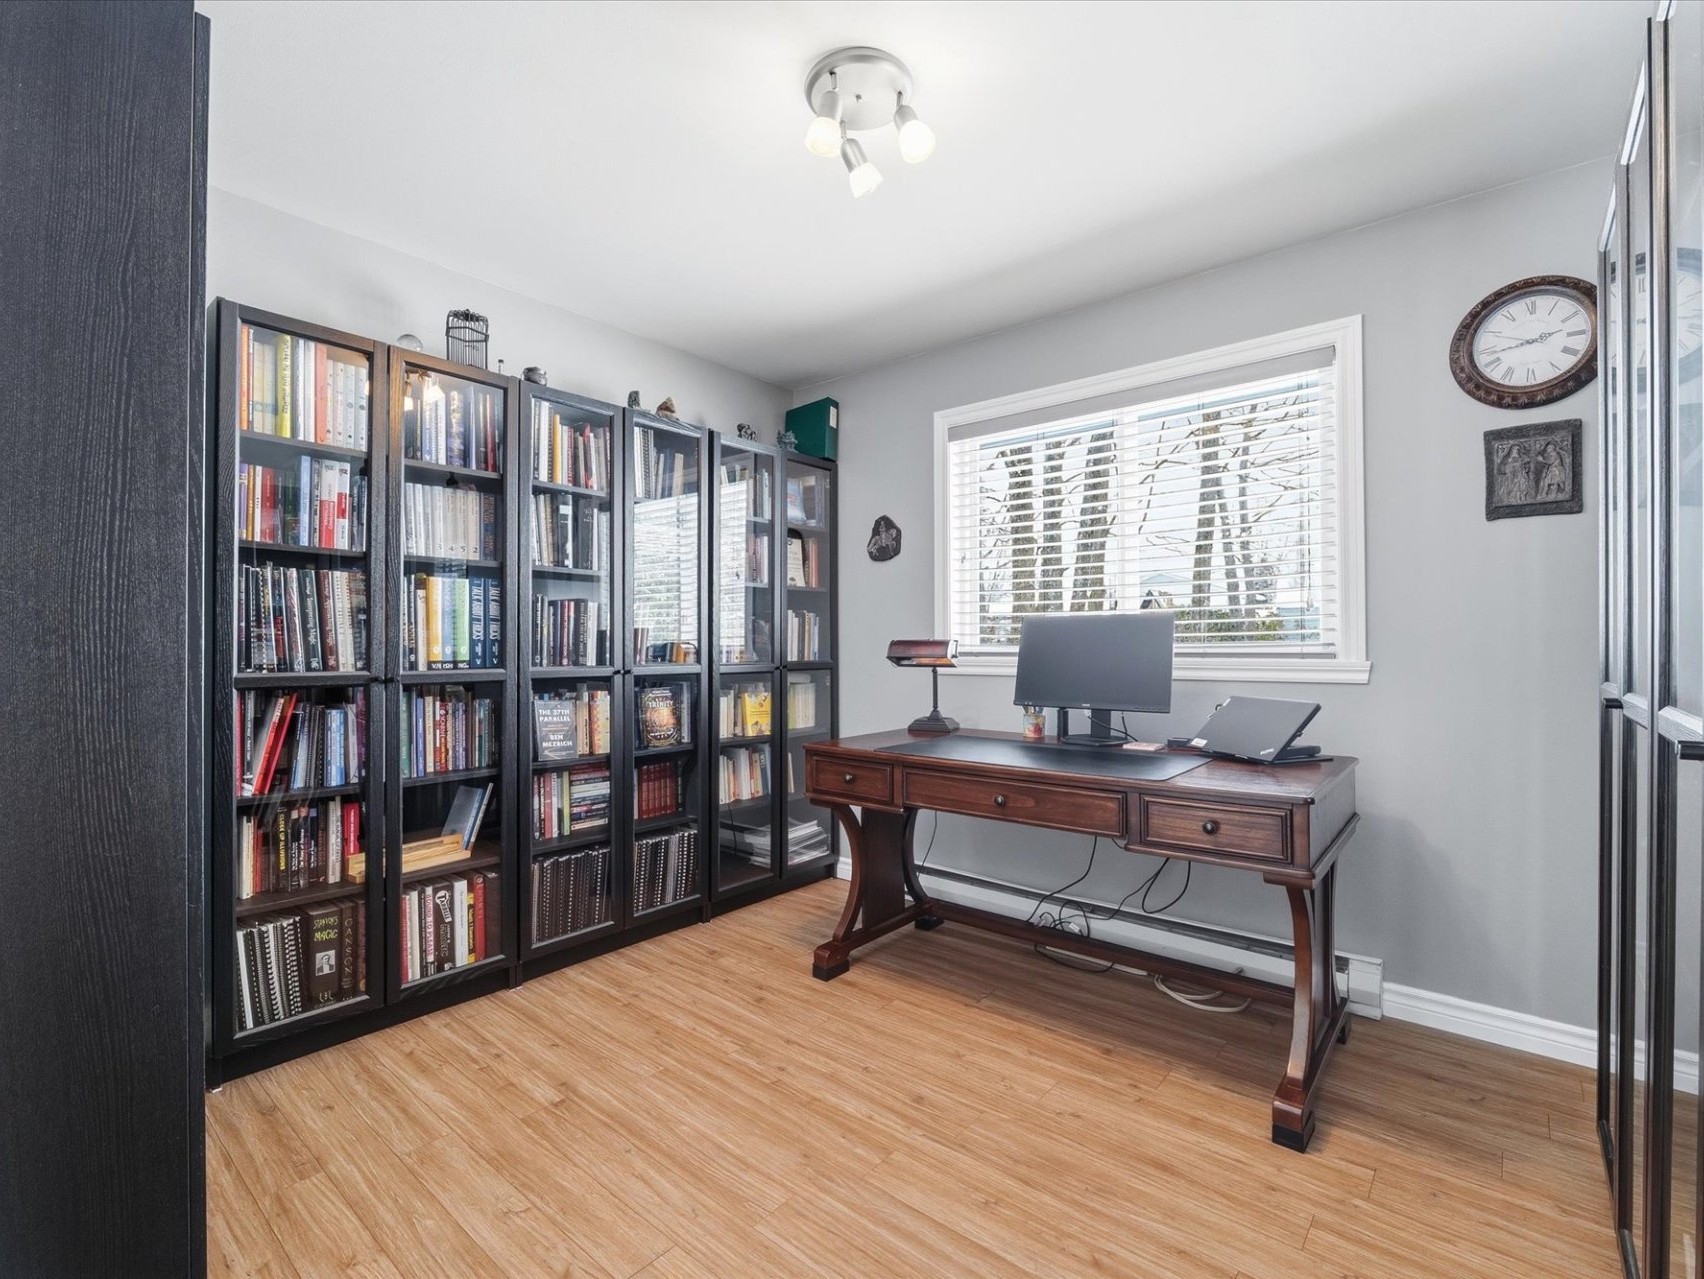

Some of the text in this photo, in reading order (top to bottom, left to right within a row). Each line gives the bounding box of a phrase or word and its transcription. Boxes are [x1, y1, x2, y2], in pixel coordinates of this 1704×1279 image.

[472, 586, 484, 600] TALK
[489, 586, 501, 600] TALK
[472, 601, 484, 620] ABOUT
[489, 601, 501, 620] ABOUT
[472, 621, 484, 640] TRICKS
[489, 621, 501, 640] TRICKS
[542, 740, 573, 748] MEZRICH
[314, 928, 338, 942] MAGIC
